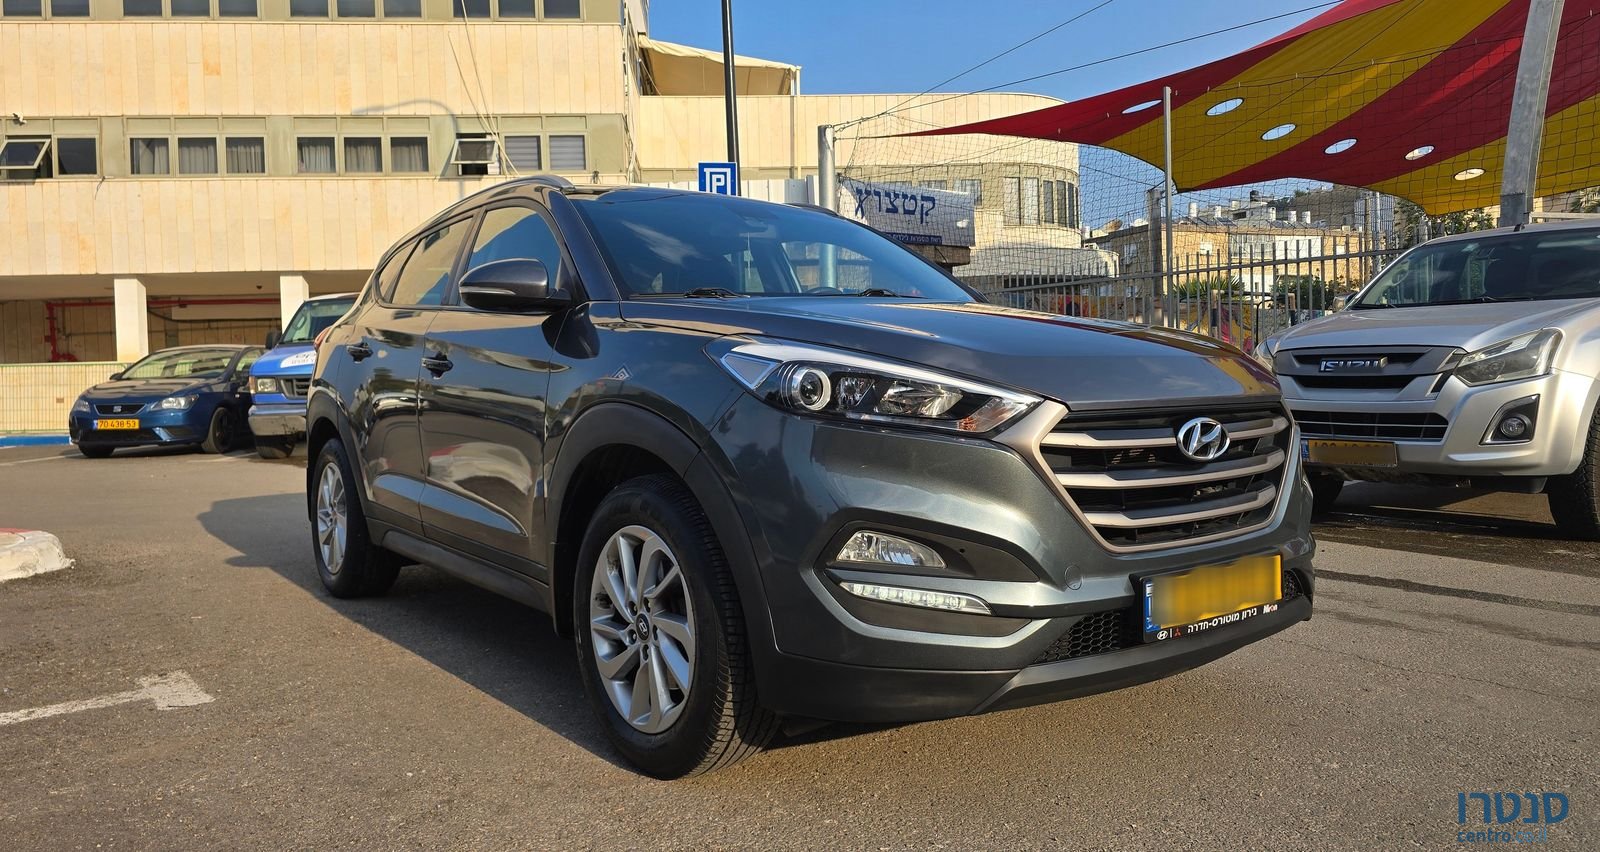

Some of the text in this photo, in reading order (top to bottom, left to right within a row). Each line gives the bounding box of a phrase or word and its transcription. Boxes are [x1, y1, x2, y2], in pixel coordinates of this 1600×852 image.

[1320, 360, 1380, 371] ISUZU
[99, 420, 109, 428] 70
[126, 420, 136, 428] 53
[1241, 607, 1257, 620] נירון
